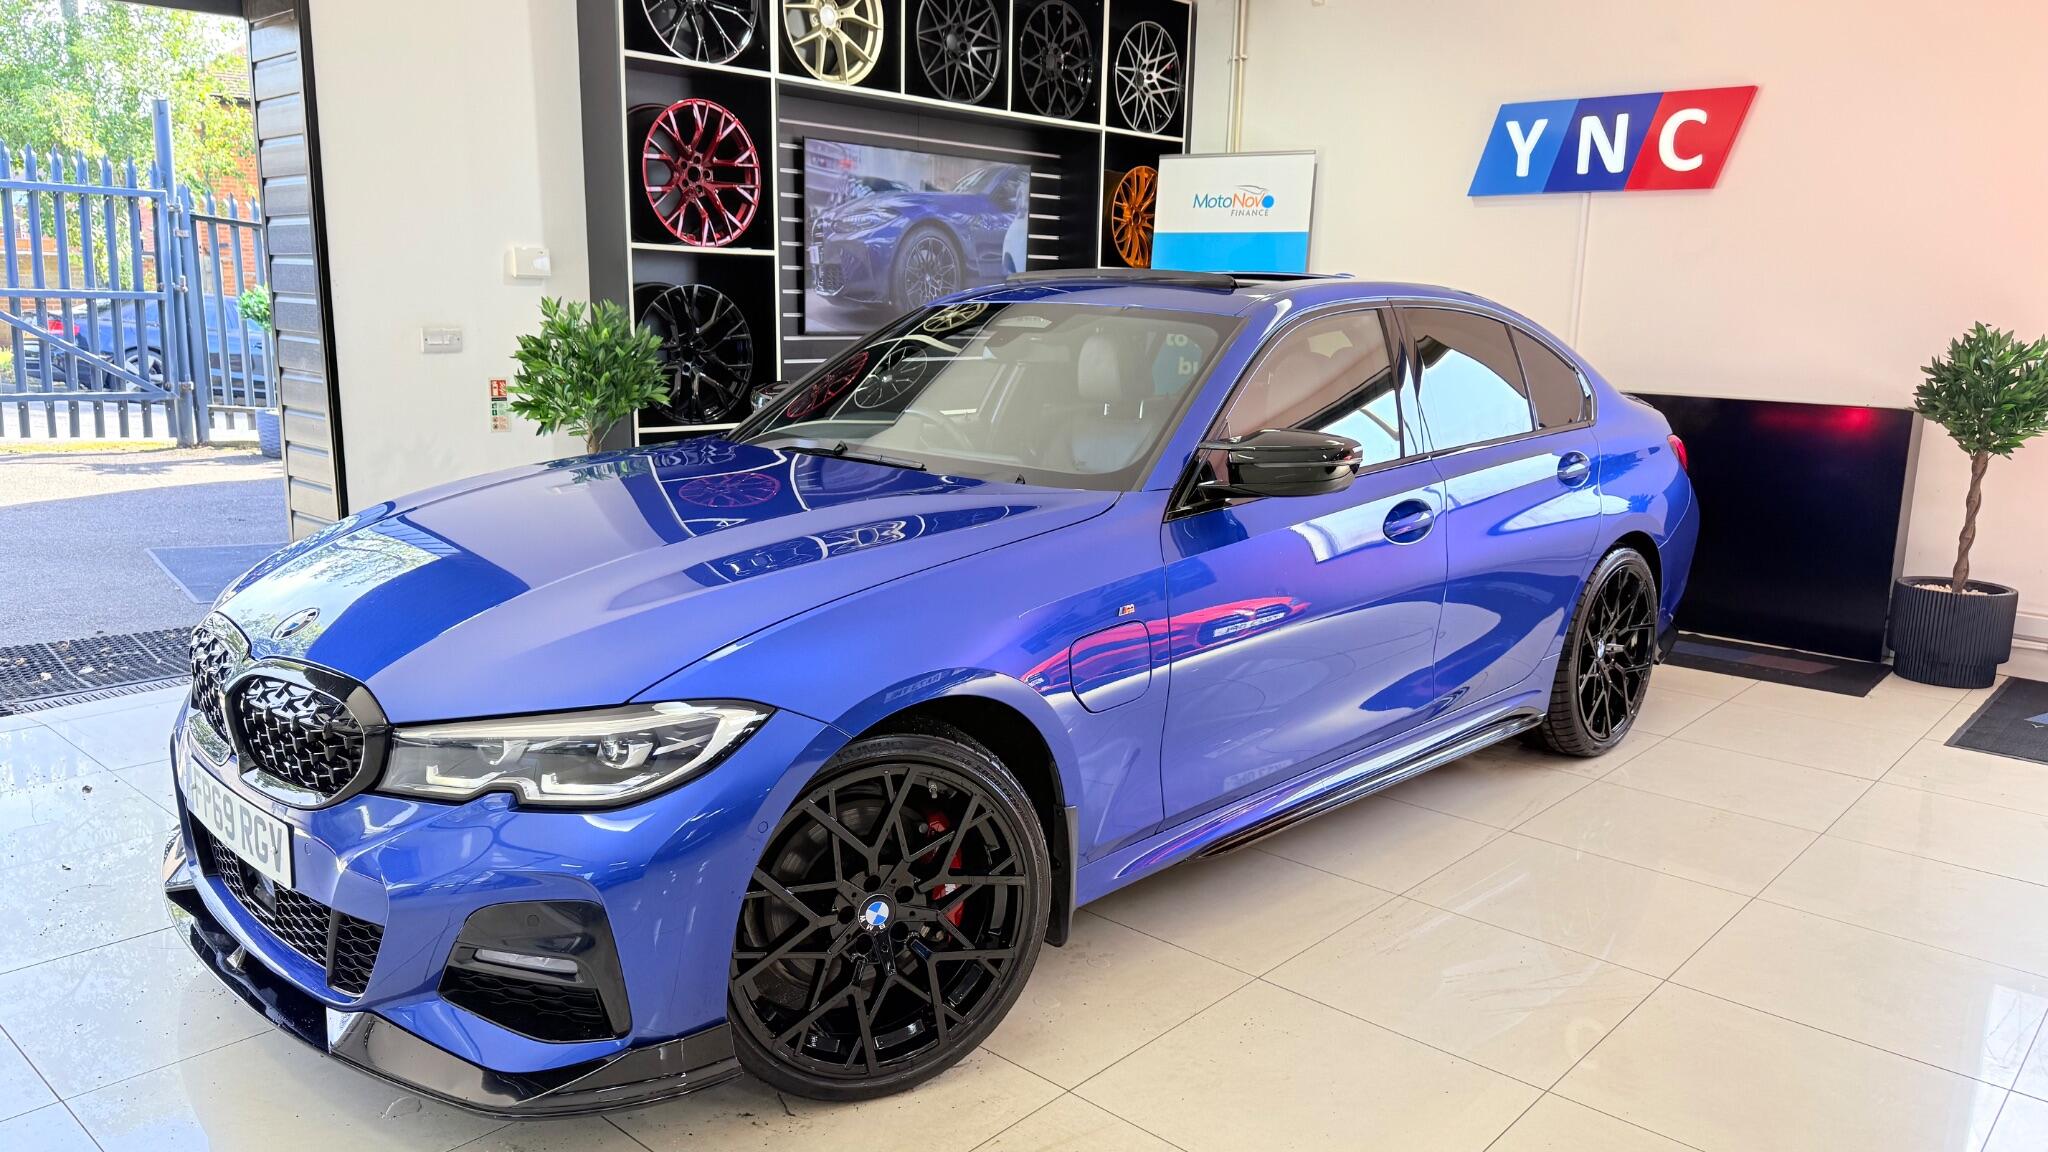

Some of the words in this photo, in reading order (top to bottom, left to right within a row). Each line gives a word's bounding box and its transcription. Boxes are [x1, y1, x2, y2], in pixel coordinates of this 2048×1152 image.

[1505, 108, 1708, 177] YNC
[1230, 209, 1270, 217] FINANCE
[191, 765, 236, 841] FP69
[239, 803, 283, 874] RGV
